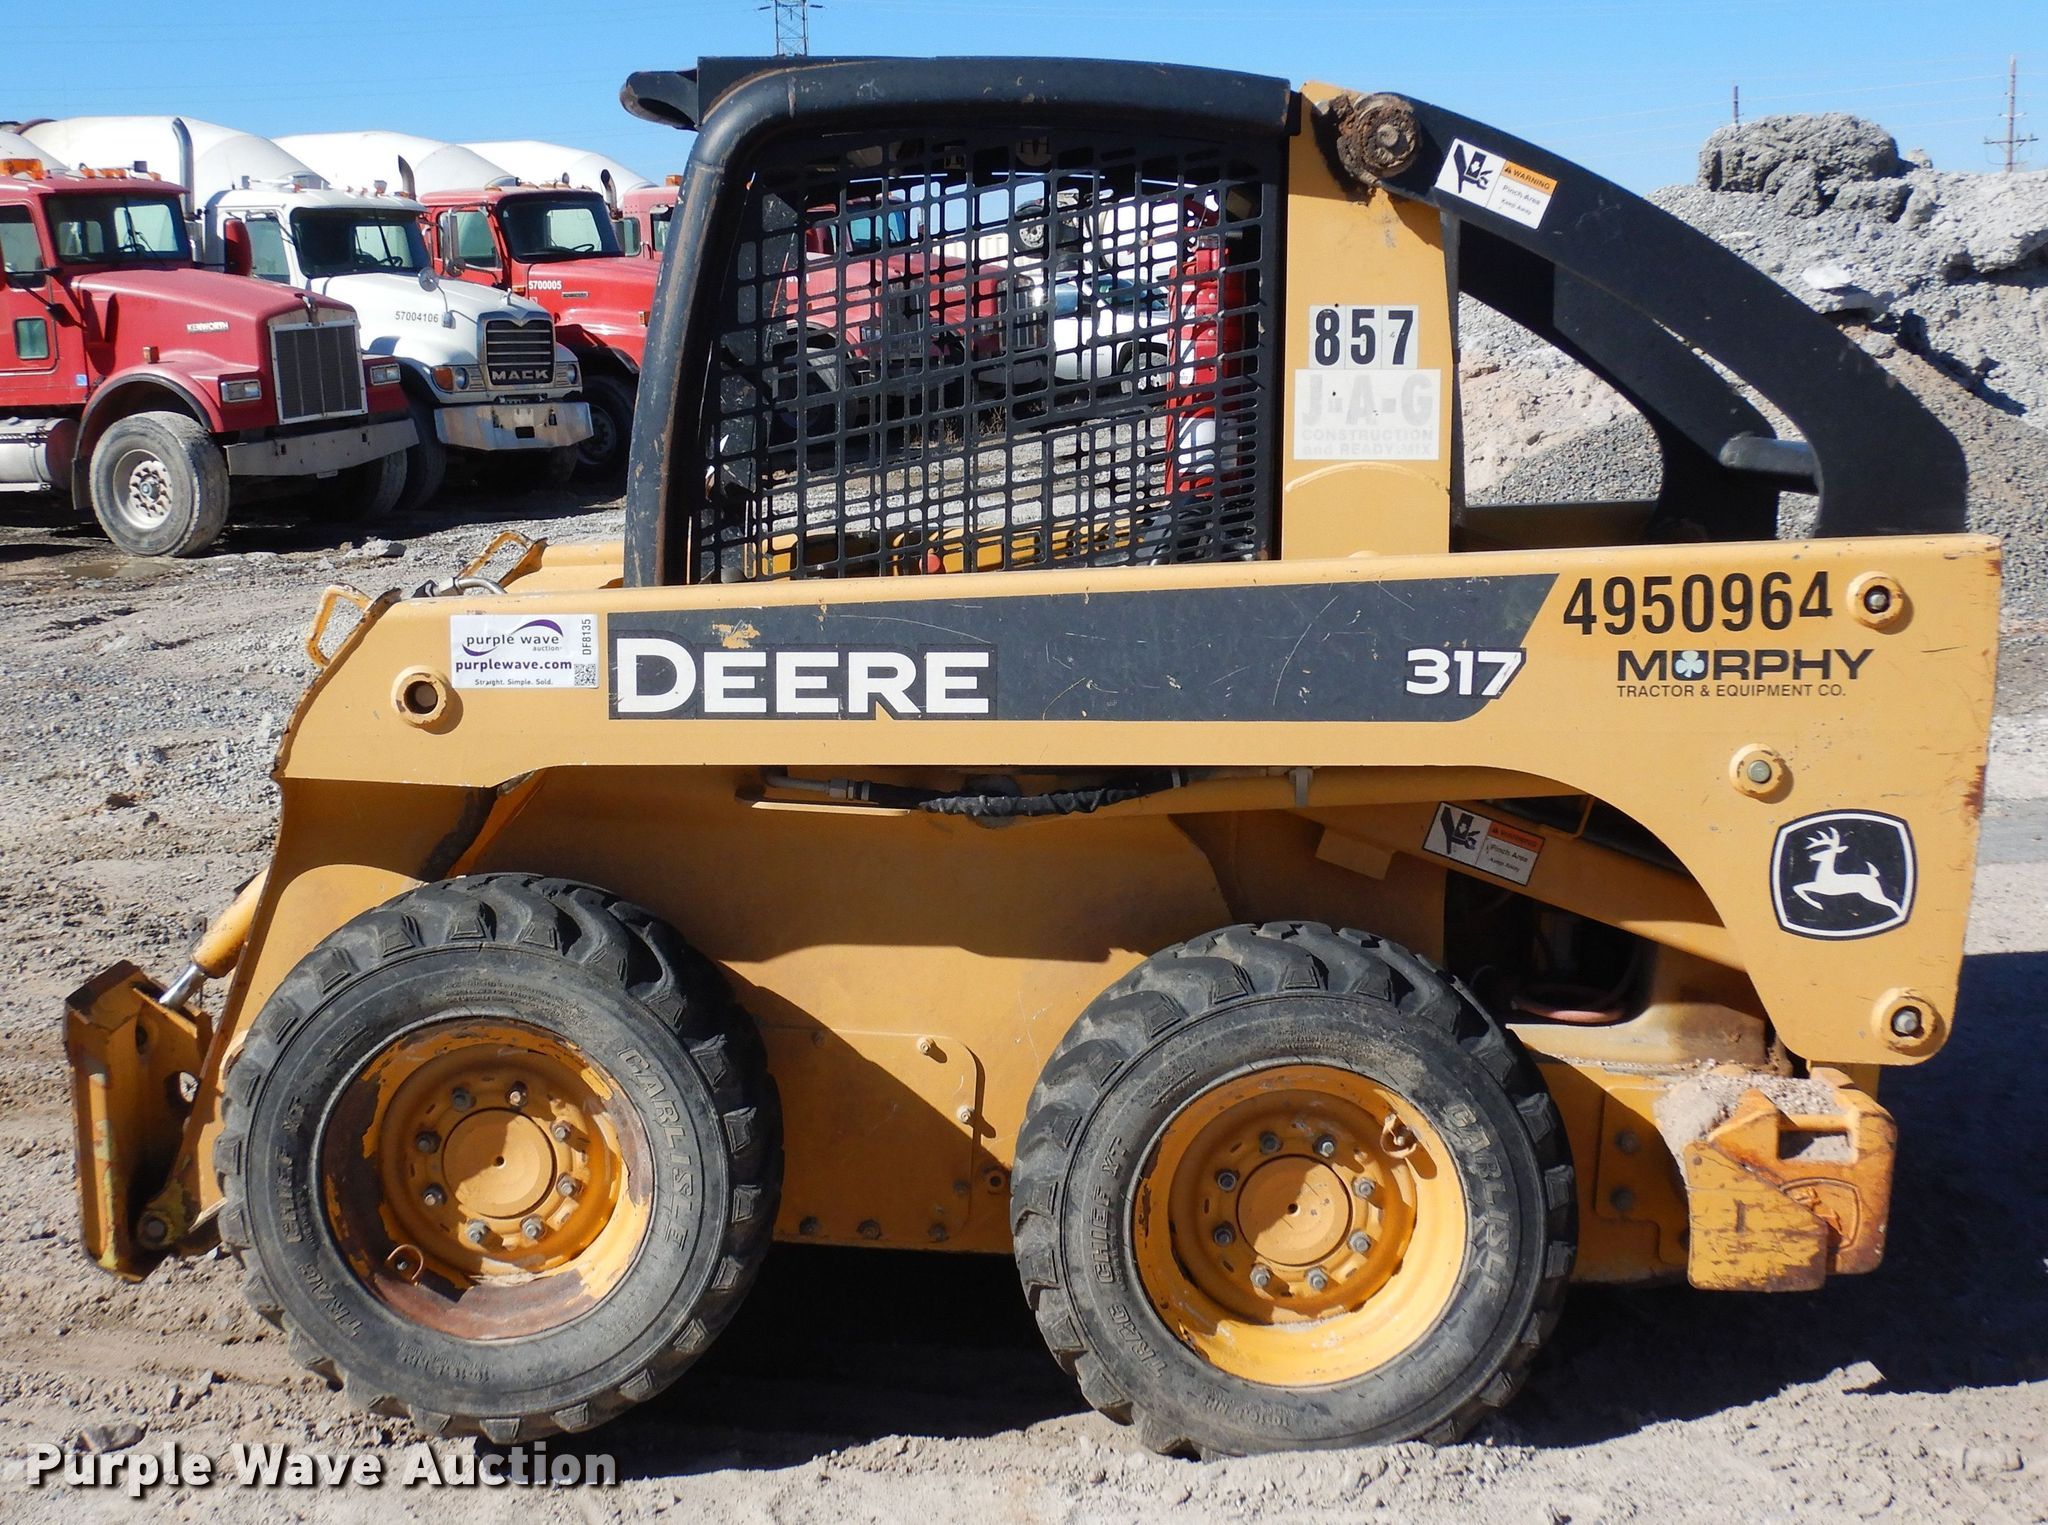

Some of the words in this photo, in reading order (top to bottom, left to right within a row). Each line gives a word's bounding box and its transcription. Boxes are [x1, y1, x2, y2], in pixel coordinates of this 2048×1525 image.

[1513, 168, 1550, 190] WARNING
[528, 279, 562, 290] 5700005
[394, 310, 439, 323] 57004106
[1314, 308, 1414, 367] 857
[491, 369, 549, 381] MACK
[1302, 427, 1432, 441] CONSTRUCTION
[1563, 571, 1833, 635] 4950964
[466, 634, 515, 647] purple
[520, 635, 559, 645] wave
[581, 618, 592, 656] DF8135
[455, 658, 572, 673] purplewave.com
[616, 637, 990, 714] DEERE
[1406, 648, 1522, 696] 317
[1617, 648, 1875, 682] MURPHY
[1617, 684, 1695, 698] TRACTOR
[1700, 684, 1711, 697] &
[1716, 684, 1812, 698] EQUIPMENT
[1818, 684, 1846, 697] CO.
[1090, 1184, 1116, 1285] CHIEF
[1108, 1302, 1168, 1379] TRAC
